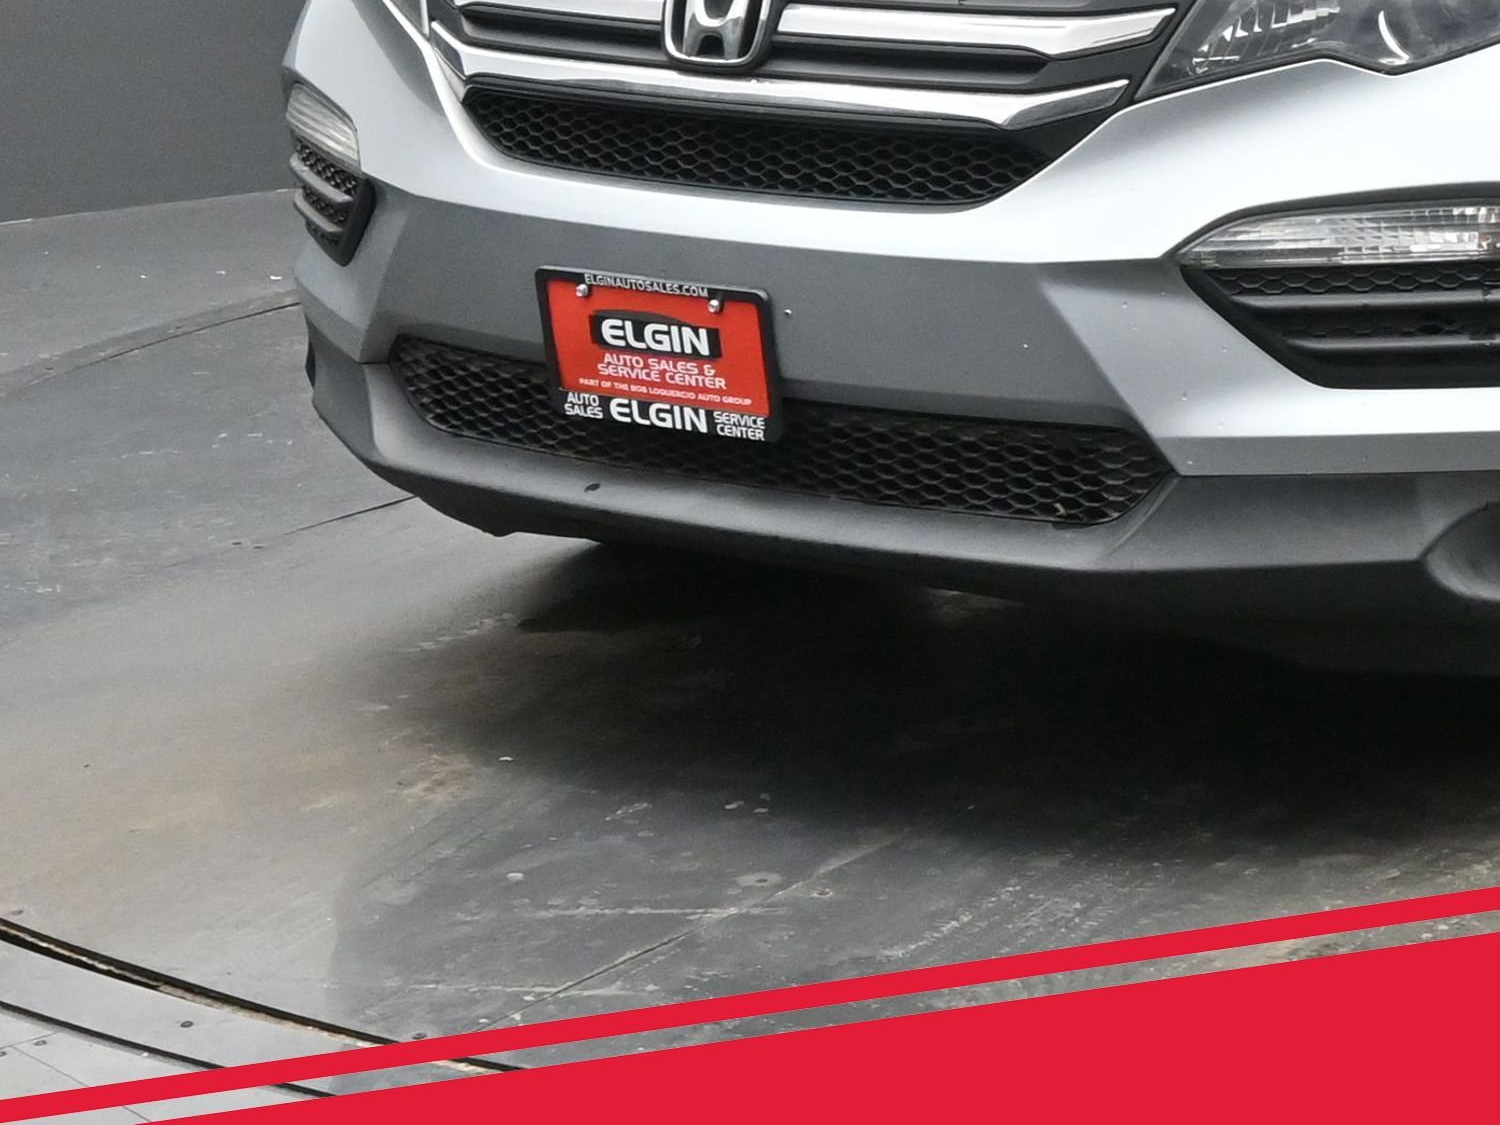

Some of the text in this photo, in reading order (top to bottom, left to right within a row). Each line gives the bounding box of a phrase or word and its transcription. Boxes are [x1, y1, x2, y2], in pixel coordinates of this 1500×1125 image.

[584, 273, 709, 298] ELGINAUTOSALES.COM
[601, 318, 711, 357] ELGIN
[597, 363, 727, 390] SERVICE CENTER
[603, 353, 716, 376] AUTO SALES &
[566, 392, 600, 408] AUTO
[579, 377, 600, 387] PART
[601, 380, 613, 388] OF
[614, 382, 629, 391] THE
[697, 393, 721, 404] AUTO
[722, 396, 752, 406] GROUP
[563, 403, 604, 420] SALES
[609, 397, 709, 434] ELGIN
[713, 411, 766, 430] SERVICE
[716, 424, 766, 442] CENTER
